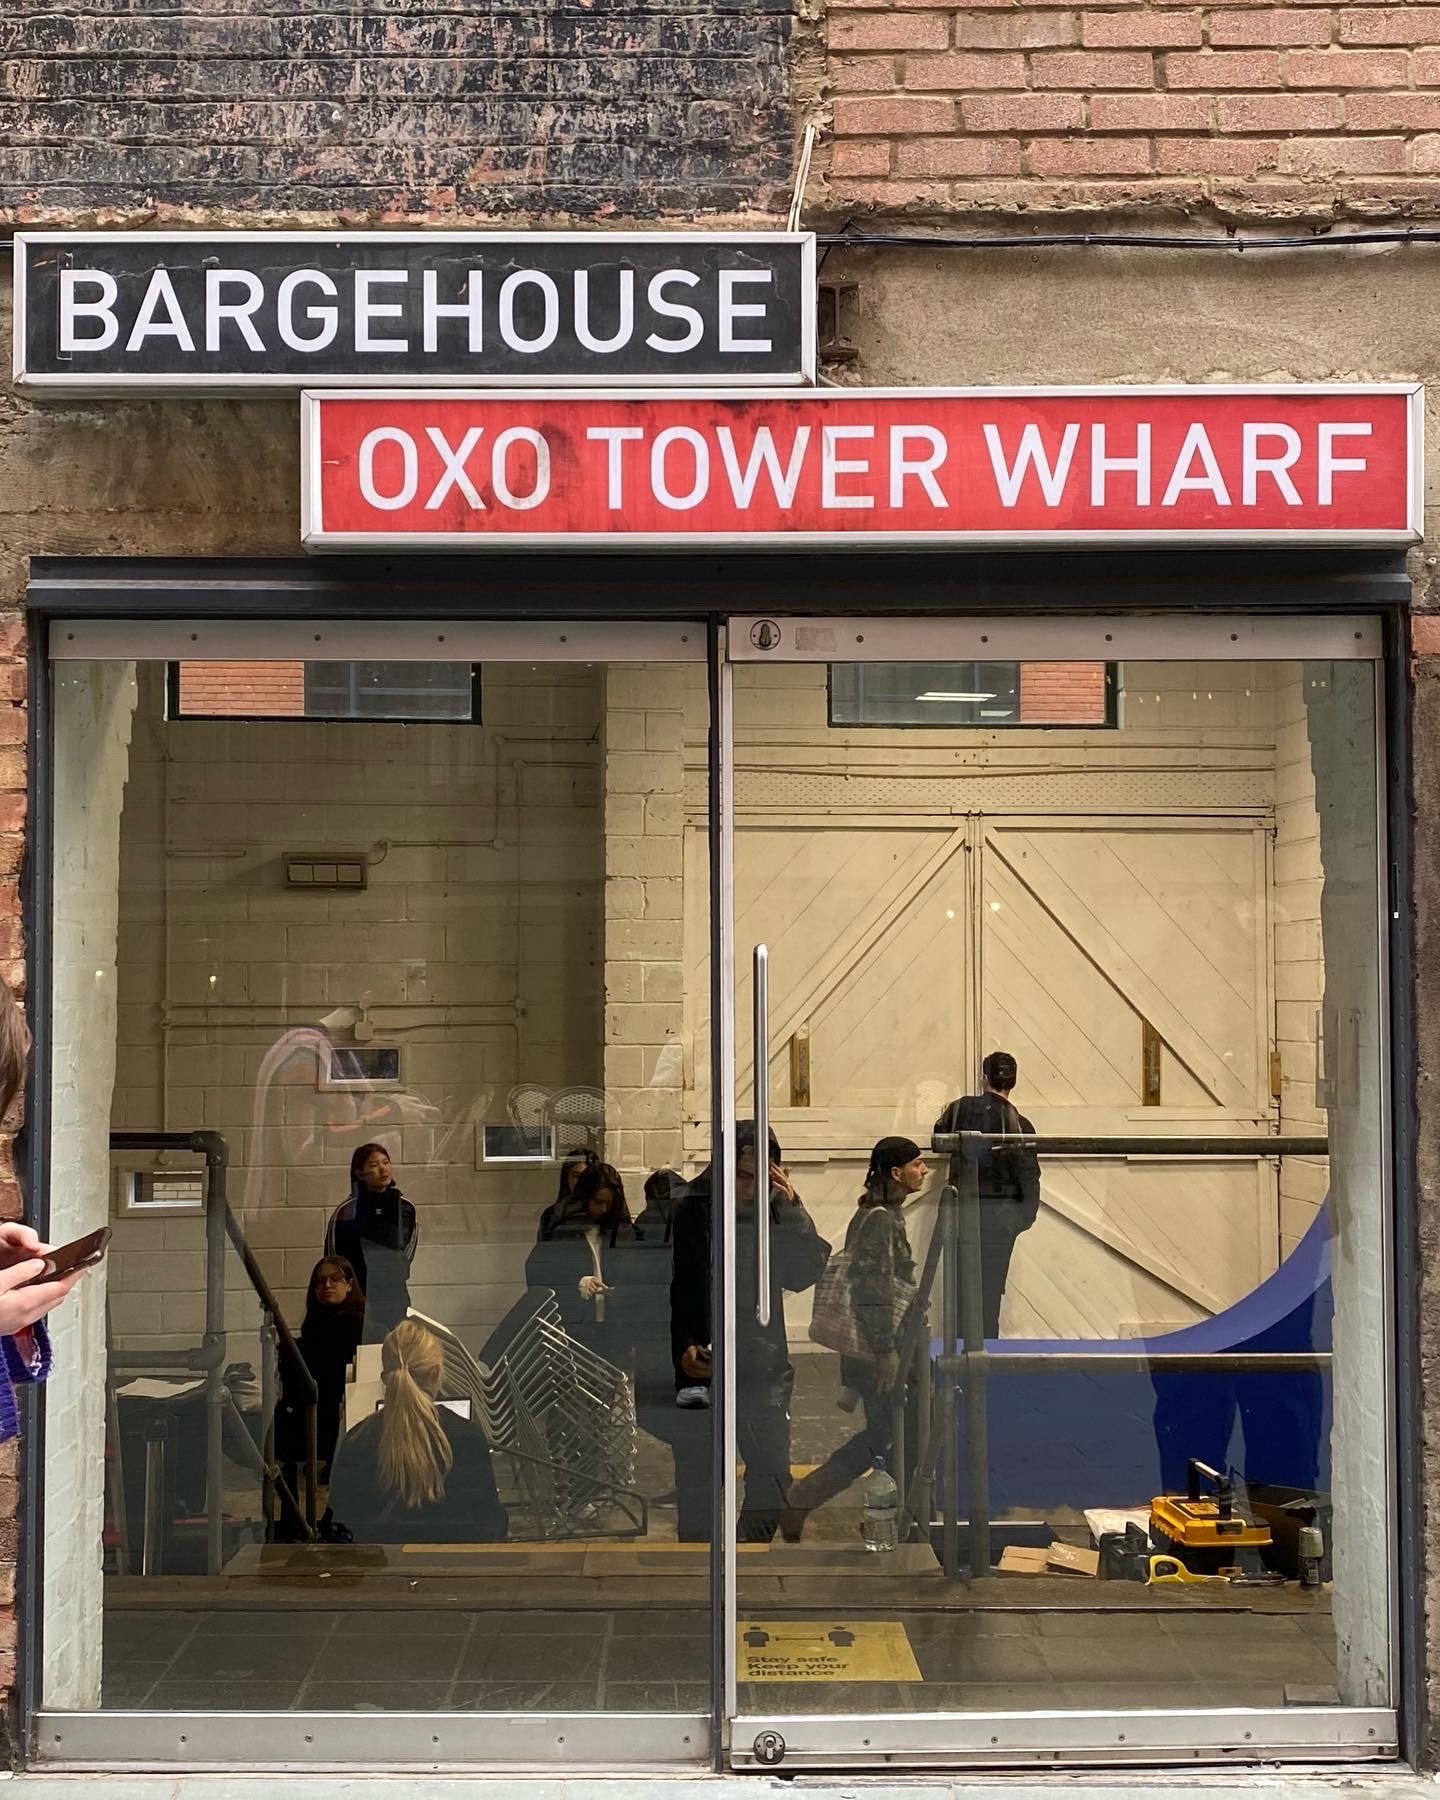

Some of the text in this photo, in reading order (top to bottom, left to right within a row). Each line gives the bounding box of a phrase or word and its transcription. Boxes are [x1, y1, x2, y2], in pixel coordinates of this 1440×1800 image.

[59, 268, 773, 354] BARGEHOUSE
[358, 422, 1373, 511] OXO TOWER WHARF
[746, 1656, 790, 1664] Stay
